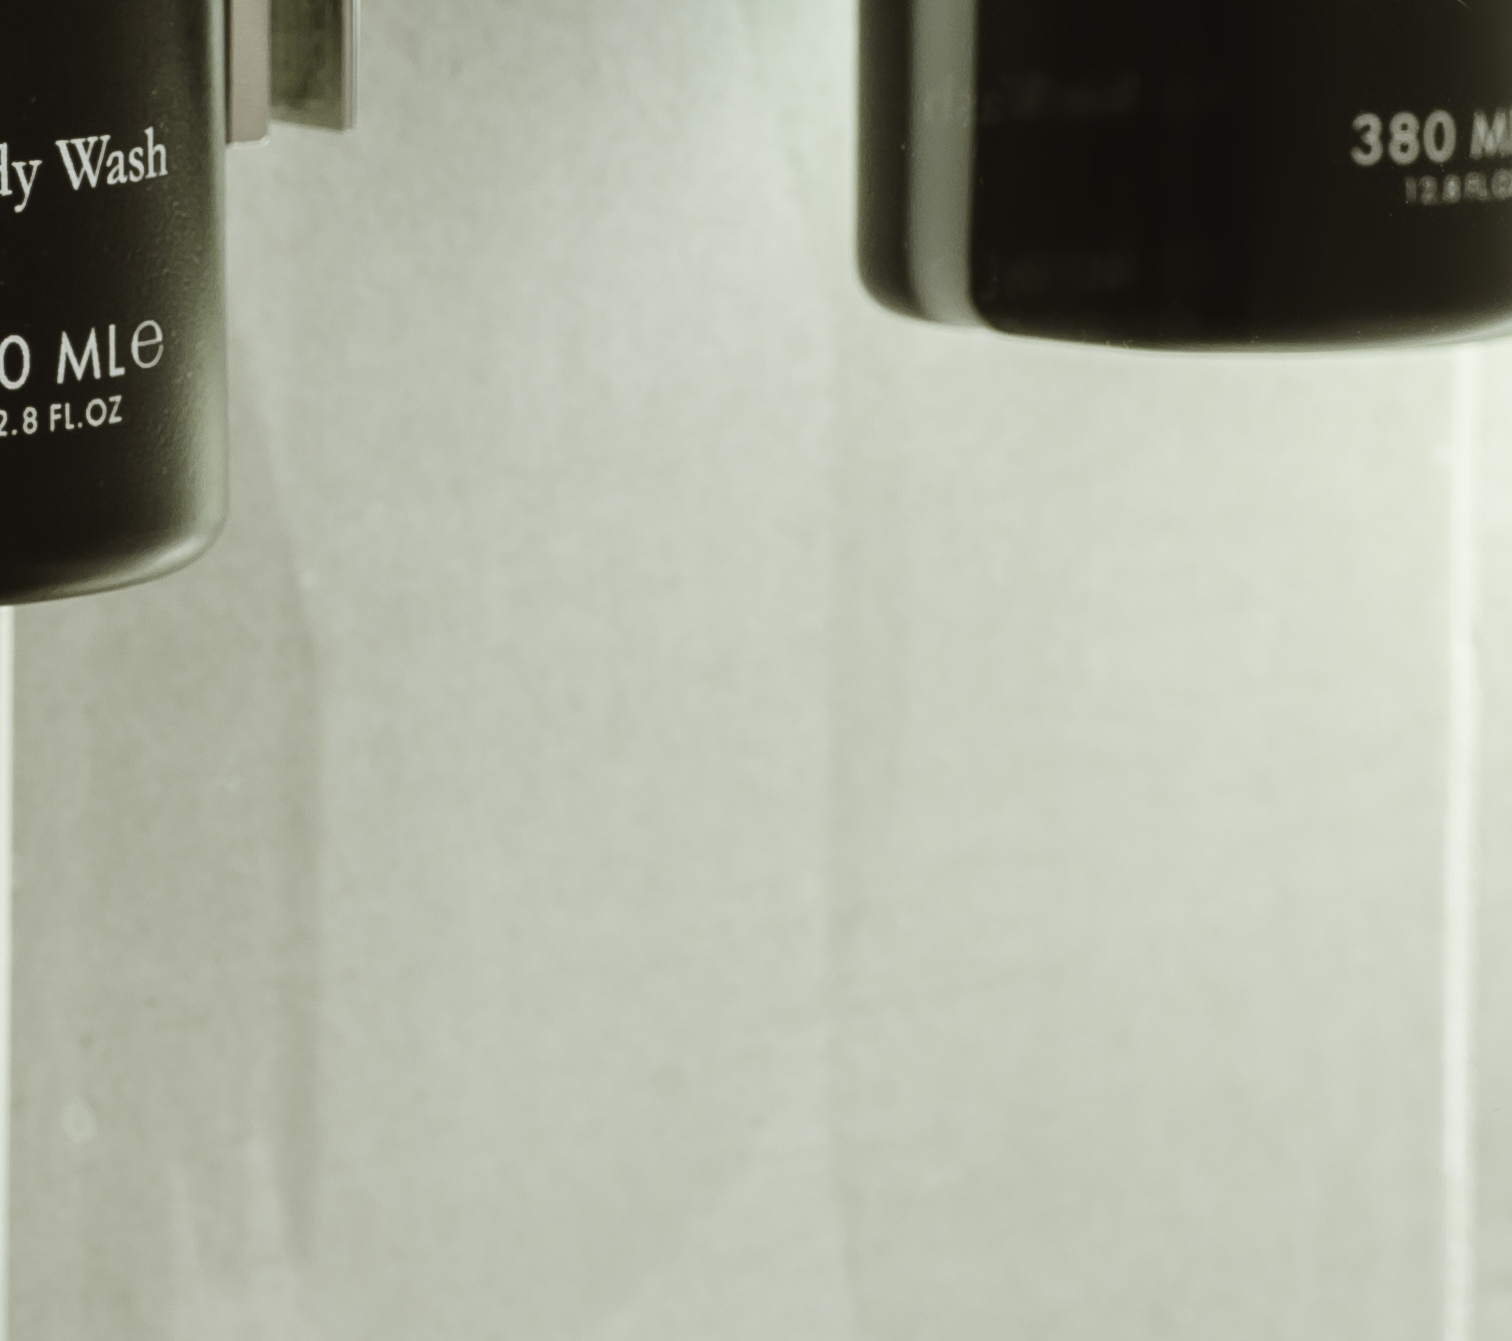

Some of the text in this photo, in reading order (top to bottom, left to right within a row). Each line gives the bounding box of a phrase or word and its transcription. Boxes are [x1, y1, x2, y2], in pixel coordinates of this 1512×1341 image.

[55, 127, 168, 190] Wash
[1350, 110, 1457, 167] 380
[50, 395, 122, 432] FL.OZ
